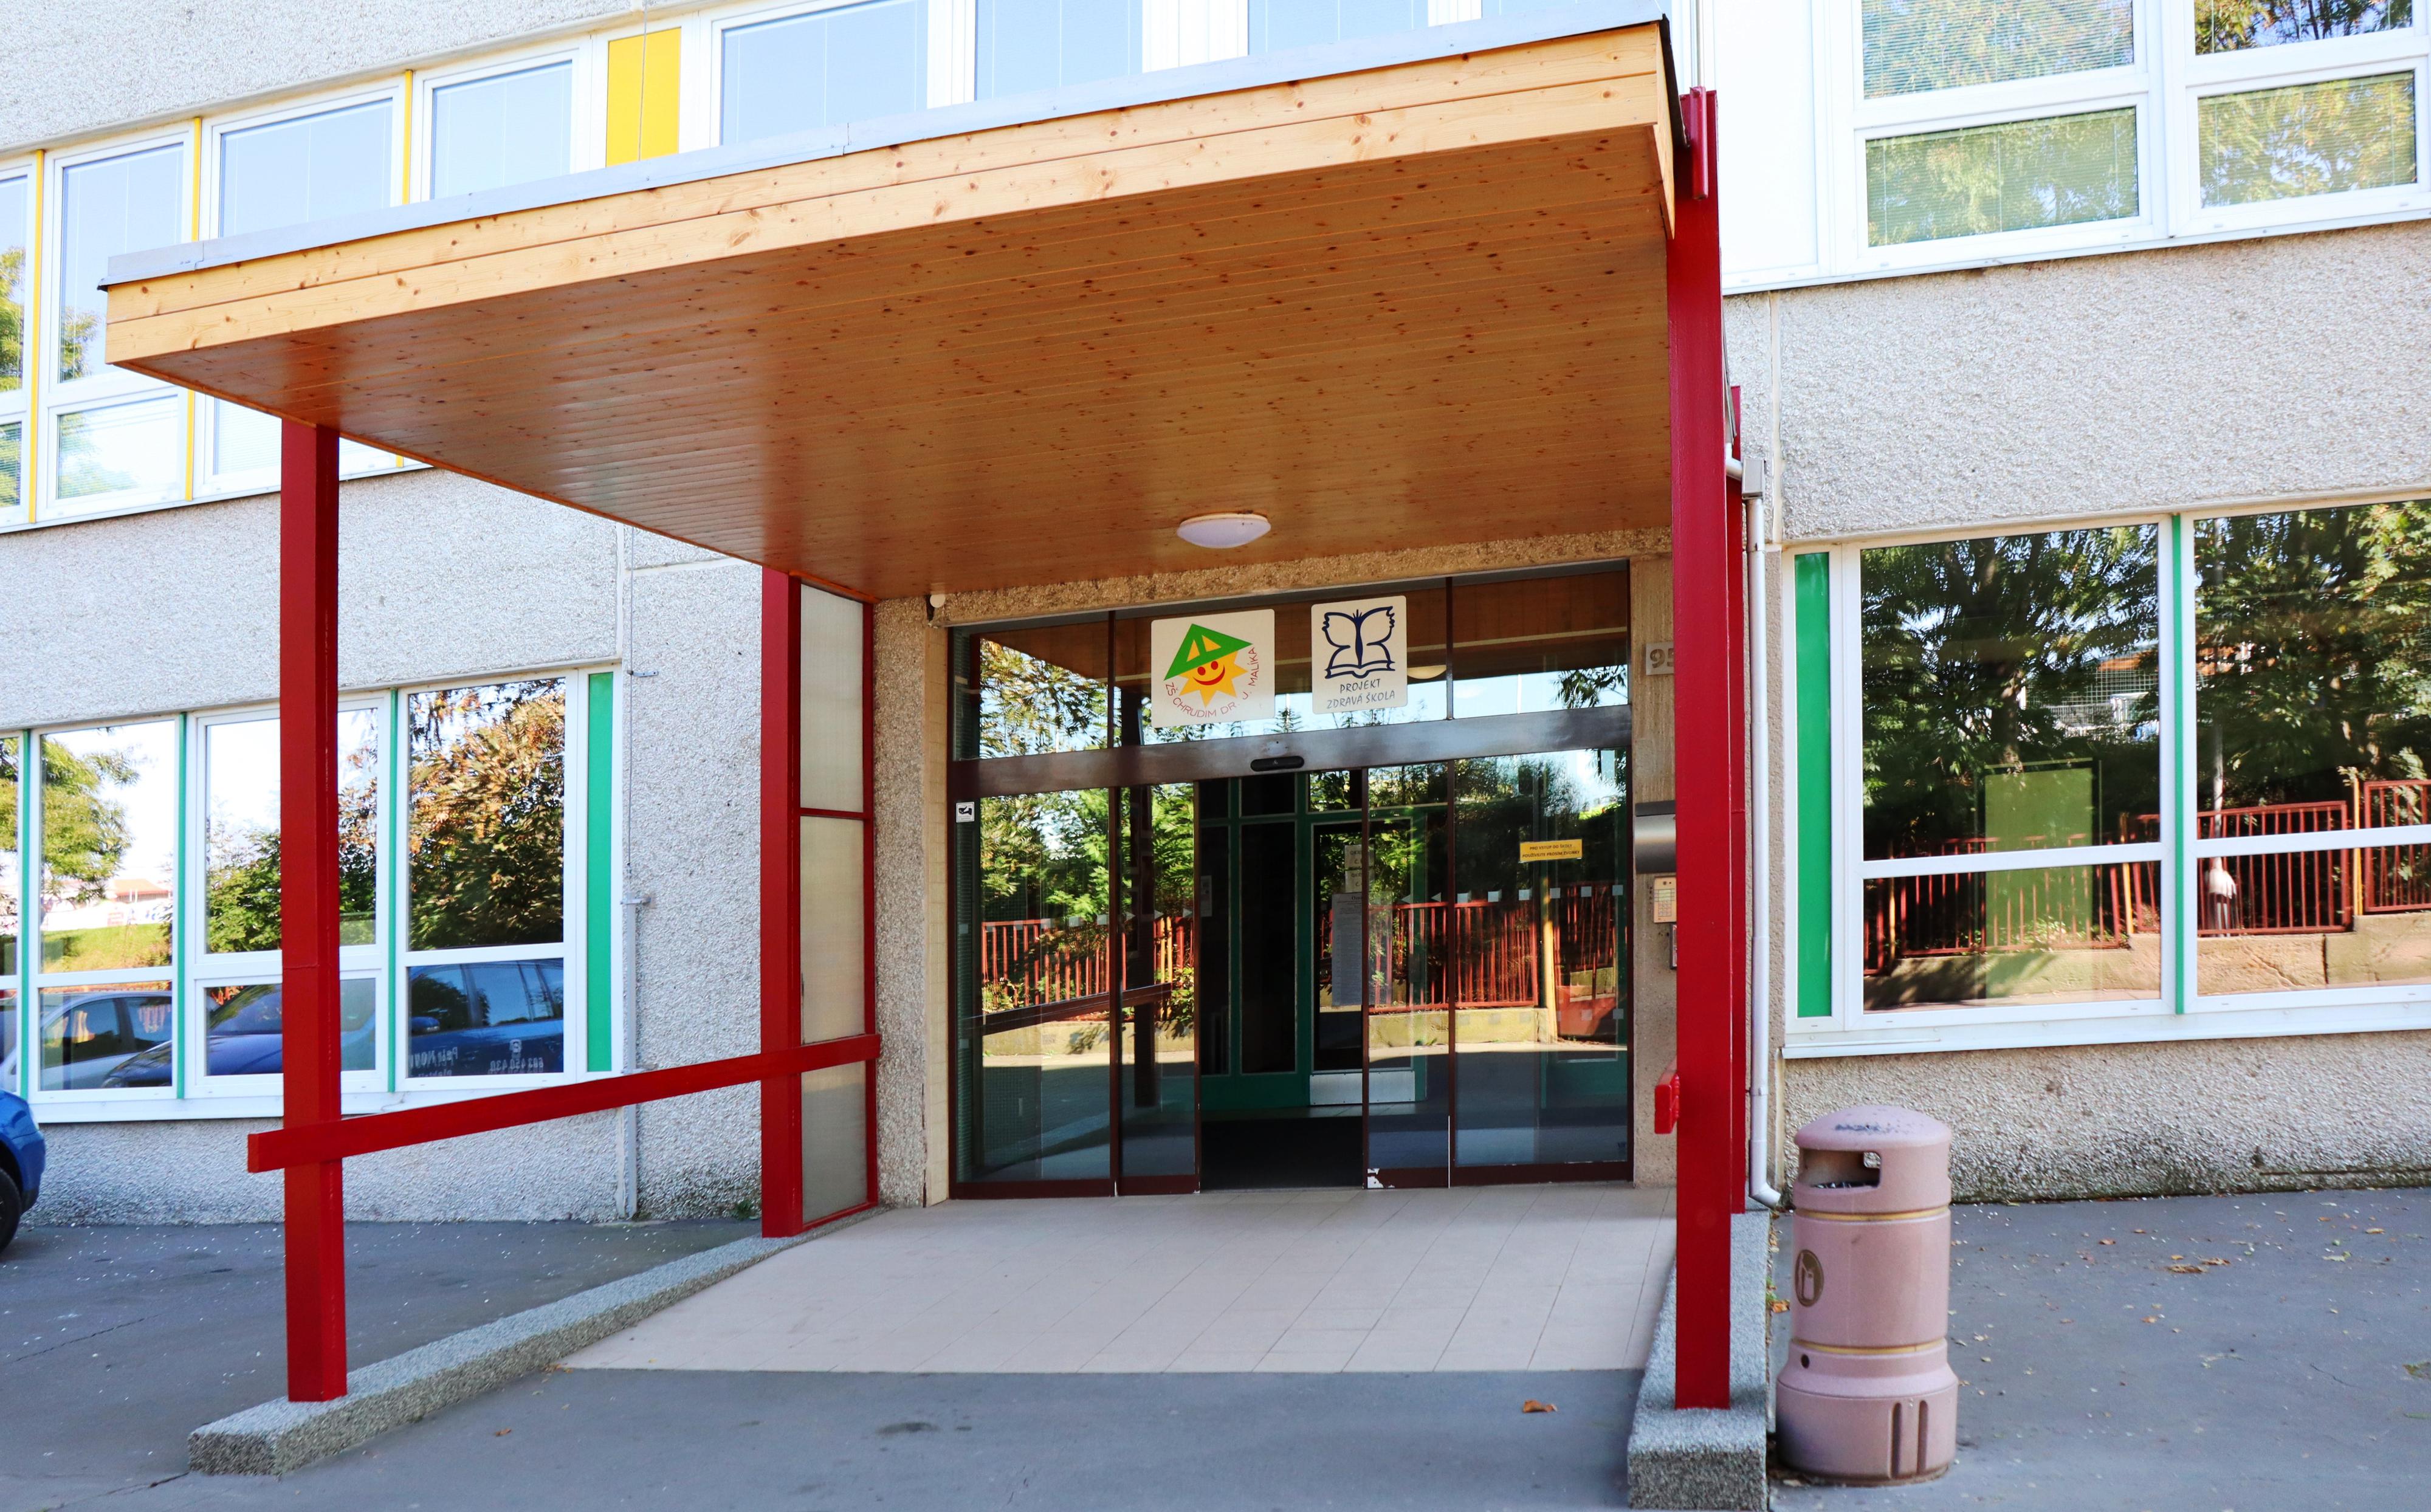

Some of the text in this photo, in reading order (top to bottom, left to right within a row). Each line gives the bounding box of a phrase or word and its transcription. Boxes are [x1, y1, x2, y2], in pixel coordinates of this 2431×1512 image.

[1165, 647, 1260, 718] ZŠ CHRUDIM DR. J. MALÍKA
[1339, 678, 1381, 694] PROJEKT
[1327, 690, 1395, 709] ZDRAVÁ ŠKOLA
